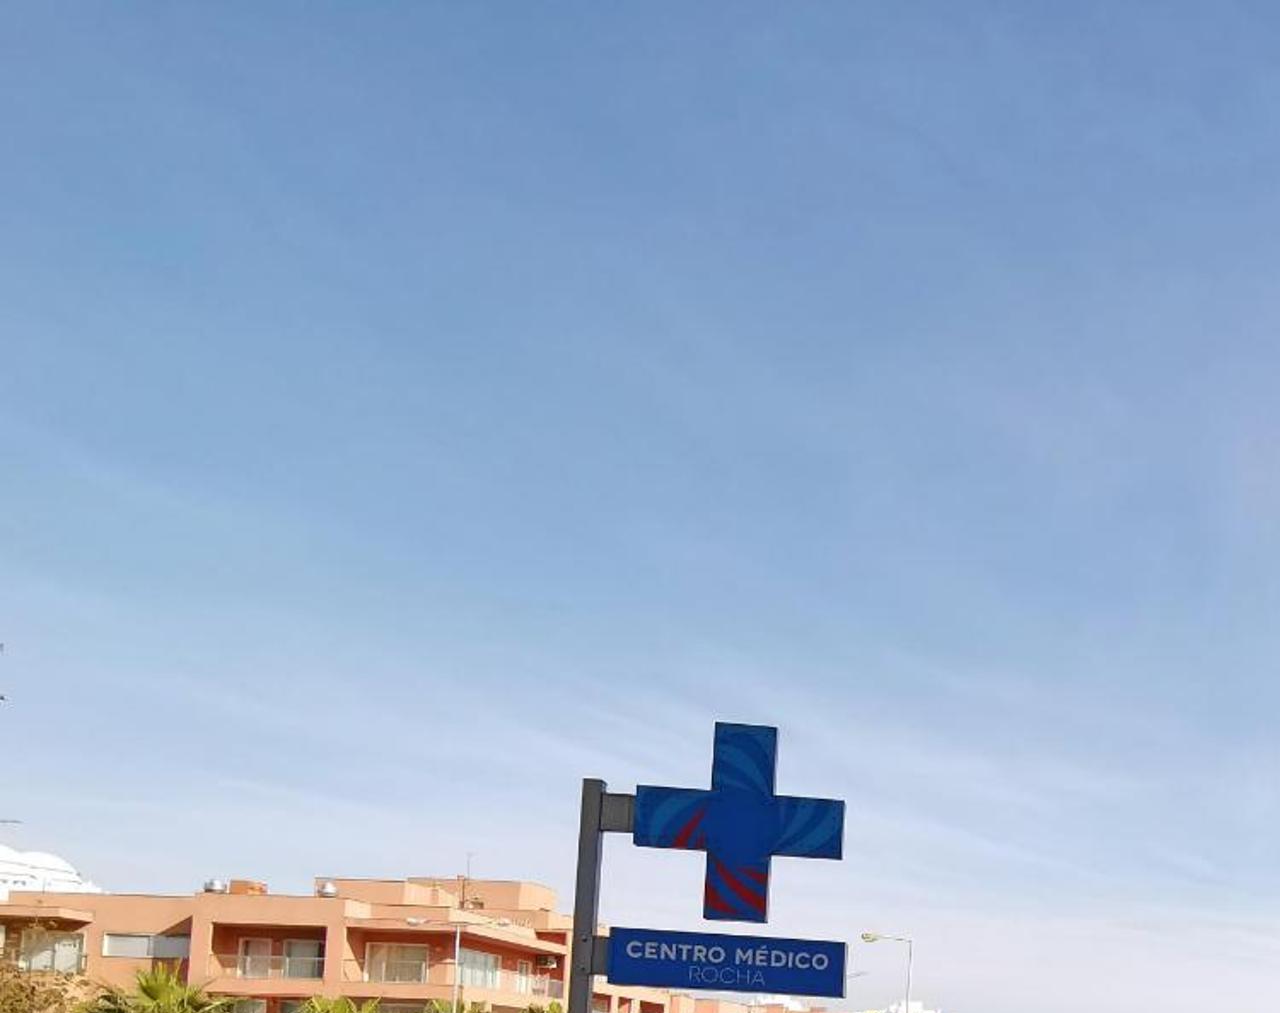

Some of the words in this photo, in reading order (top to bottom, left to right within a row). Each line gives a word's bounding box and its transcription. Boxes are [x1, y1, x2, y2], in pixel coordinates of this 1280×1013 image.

[626, 940, 725, 963] CENTRO
[735, 945, 829, 970] MÉDICO
[688, 965, 765, 986] ROCHA
